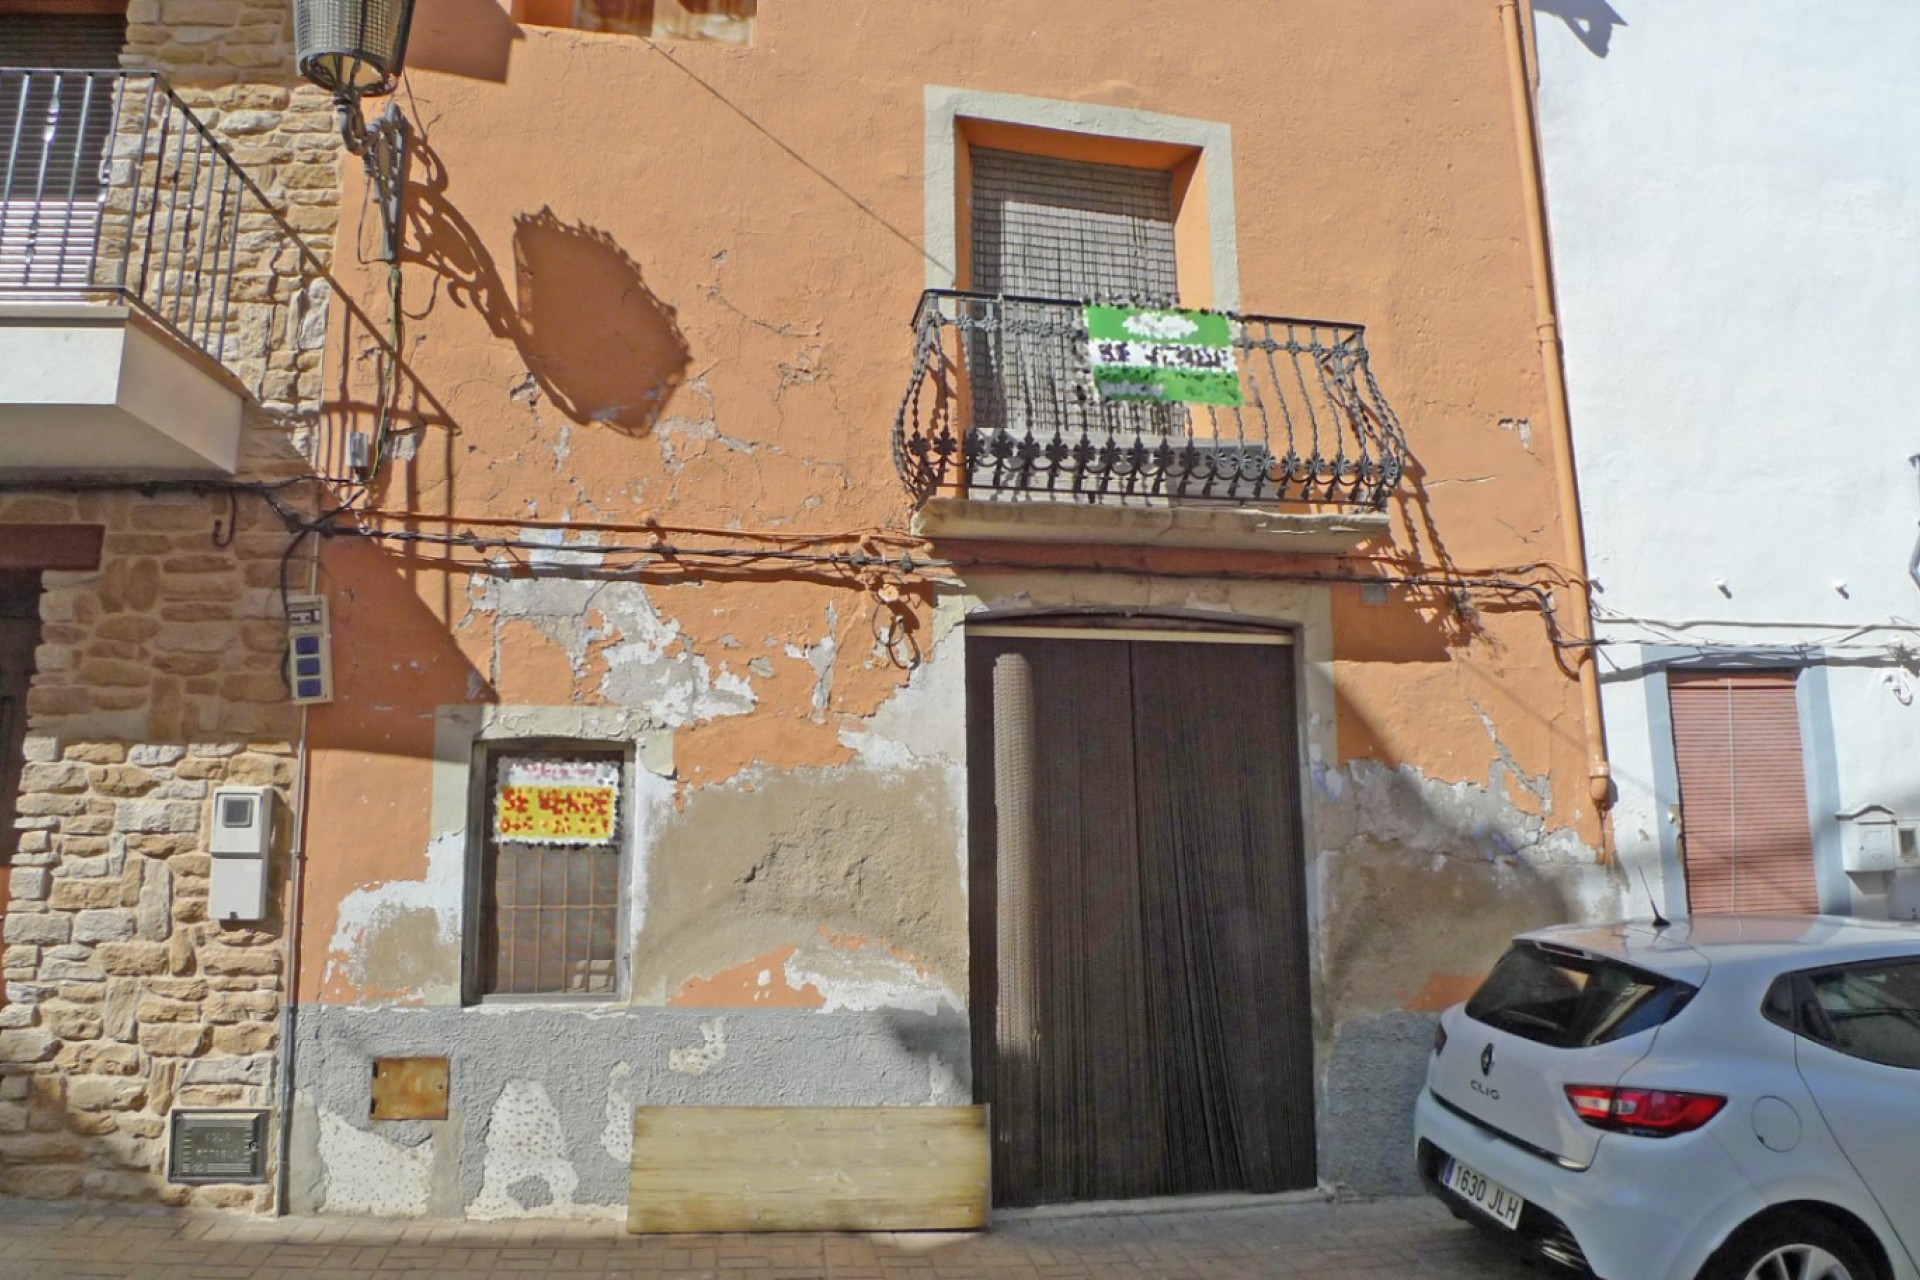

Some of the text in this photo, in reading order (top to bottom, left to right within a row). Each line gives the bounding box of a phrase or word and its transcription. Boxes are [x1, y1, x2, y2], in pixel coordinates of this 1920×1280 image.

[502, 788, 529, 813] SE
[1470, 1079, 1499, 1100] CLIO
[1455, 1165, 1519, 1223] 1630 JLH
